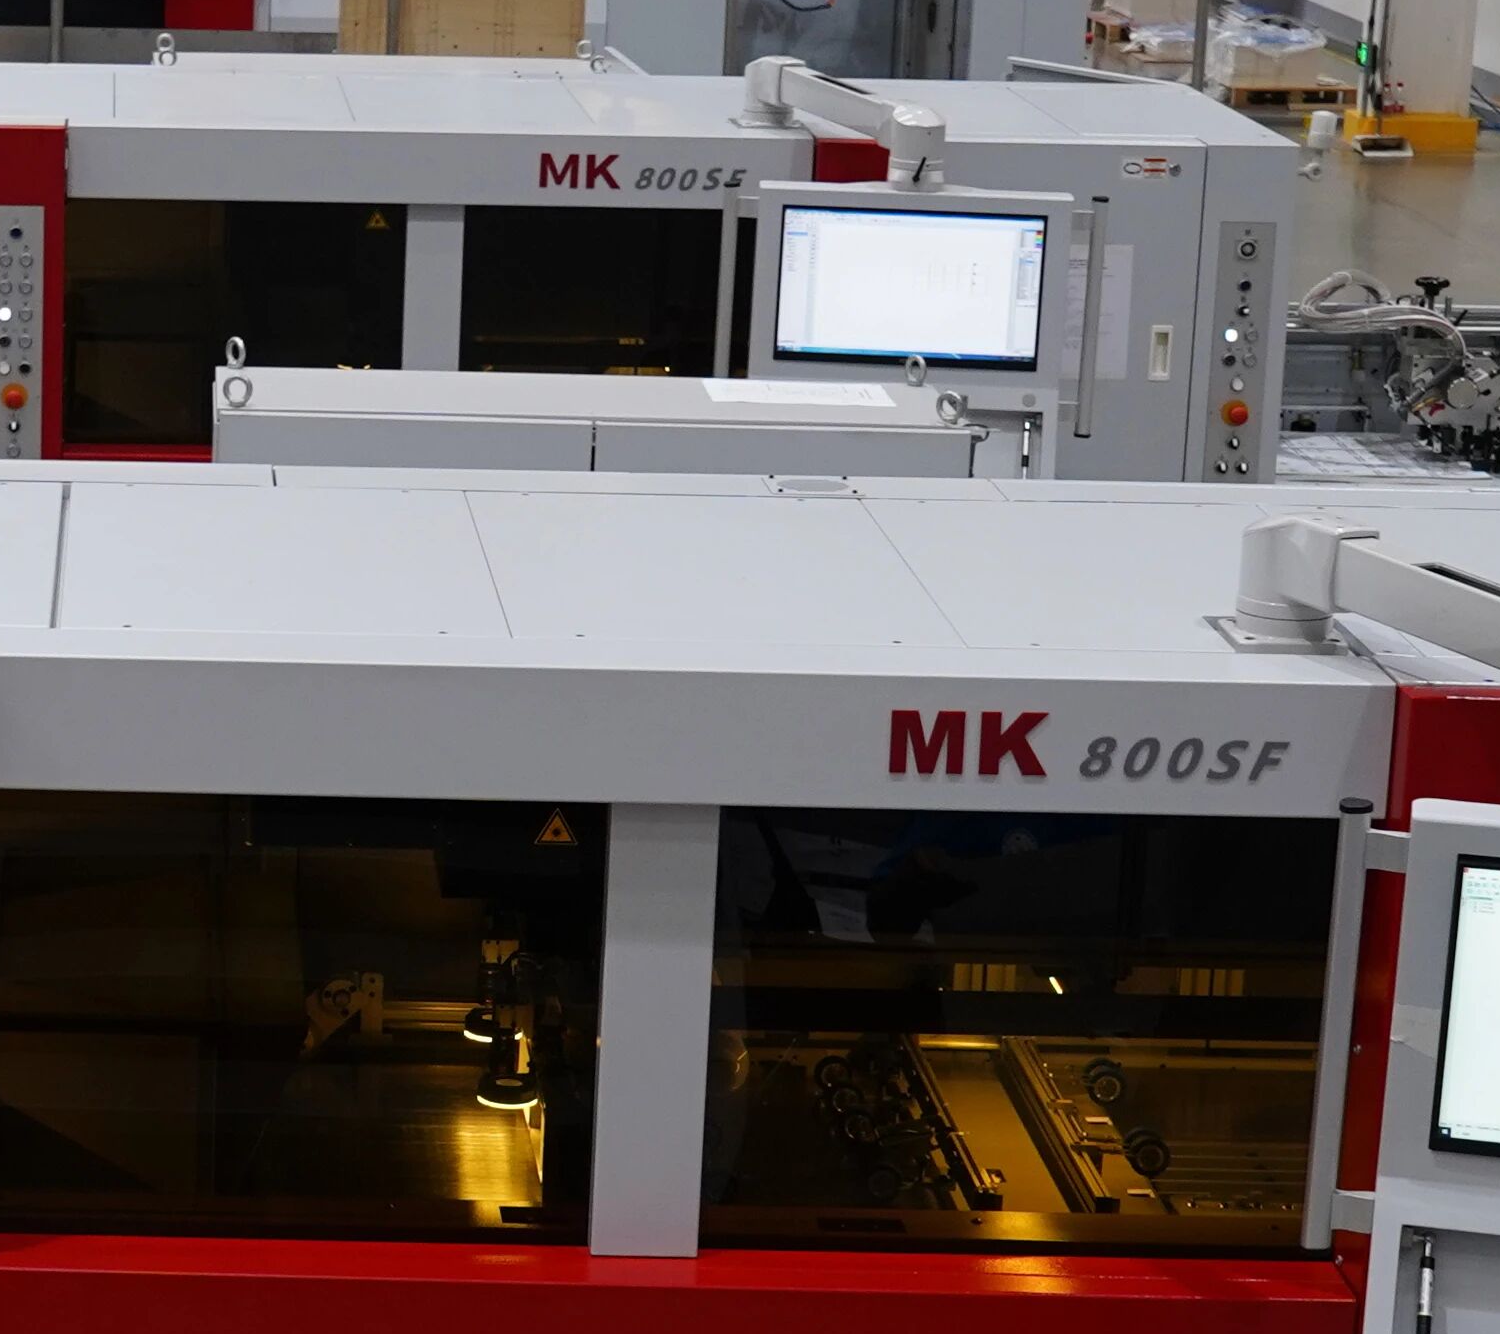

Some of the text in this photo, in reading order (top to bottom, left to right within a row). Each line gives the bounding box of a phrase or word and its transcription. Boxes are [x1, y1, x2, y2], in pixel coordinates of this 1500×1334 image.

[539, 152, 620, 189] MK
[888, 708, 1291, 784] MK 800SF
